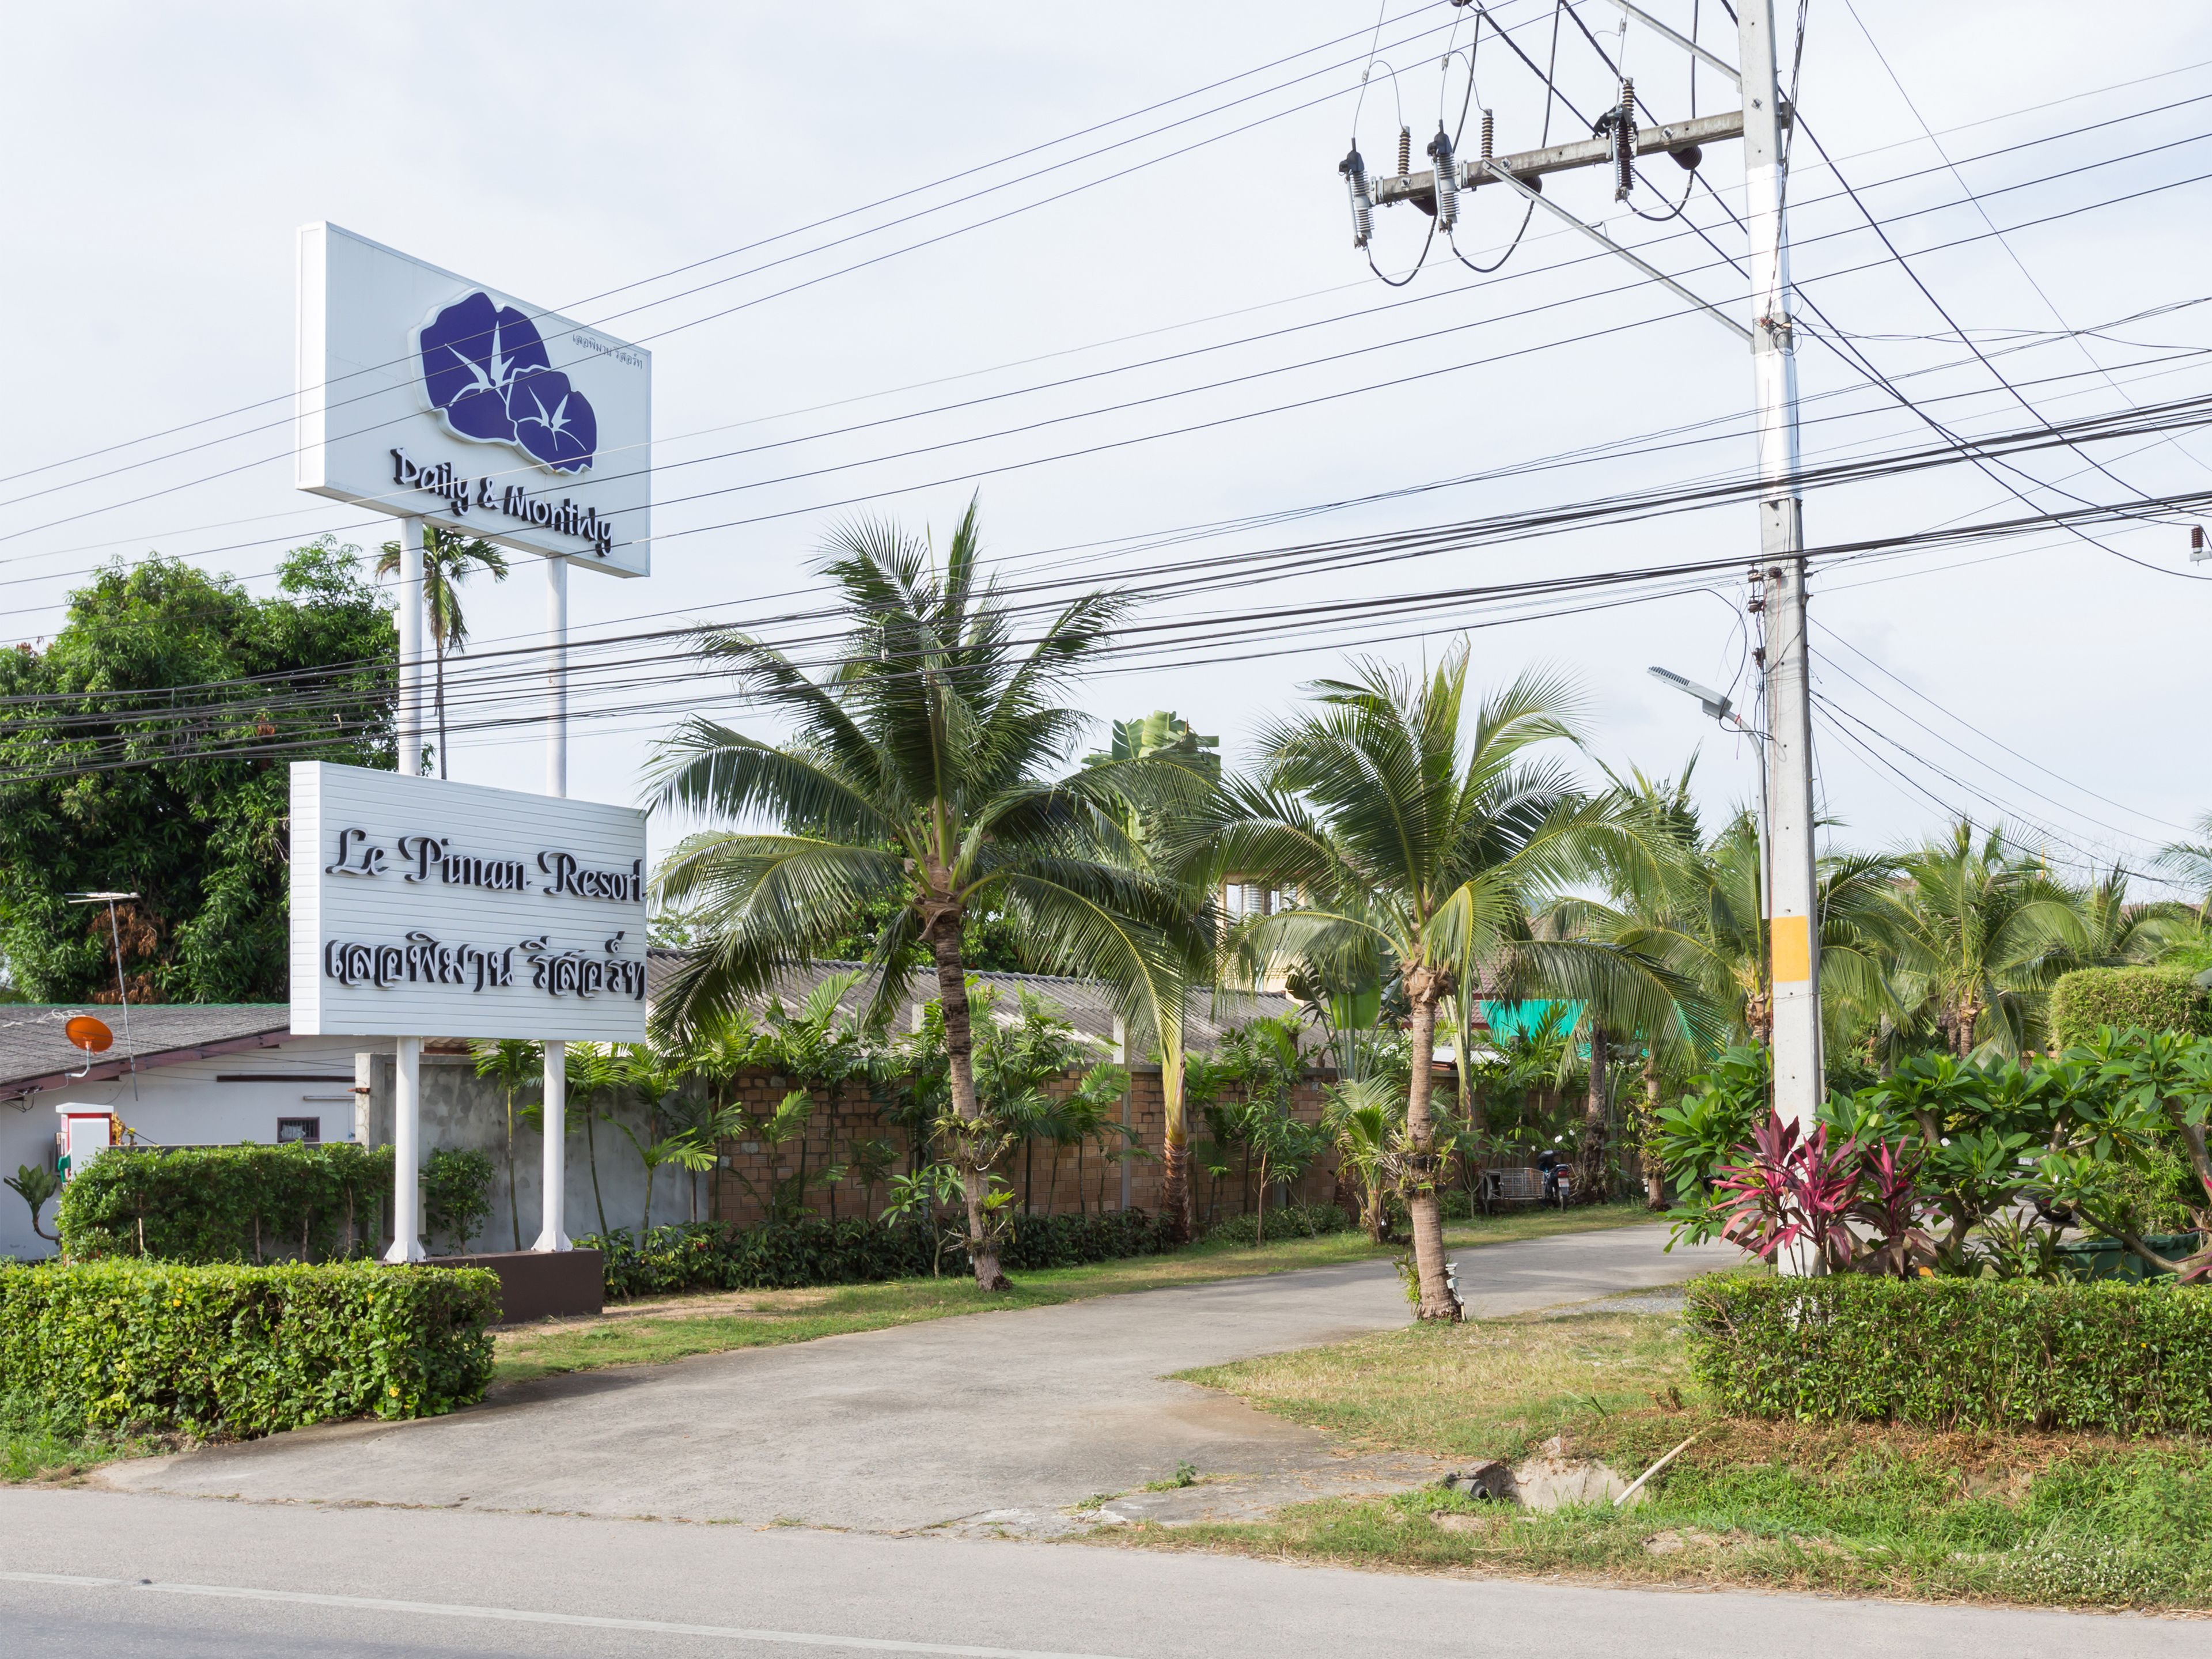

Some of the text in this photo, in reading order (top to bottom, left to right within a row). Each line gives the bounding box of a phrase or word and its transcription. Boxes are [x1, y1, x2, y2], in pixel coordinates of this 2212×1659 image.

[573, 334, 612, 357] เลอพิมาน
[390, 448, 613, 557] Daily & Monthly
[325, 827, 647, 902] Le Piman Resort
[325, 930, 646, 1000] เลอพิมาน รีสอร์ท
